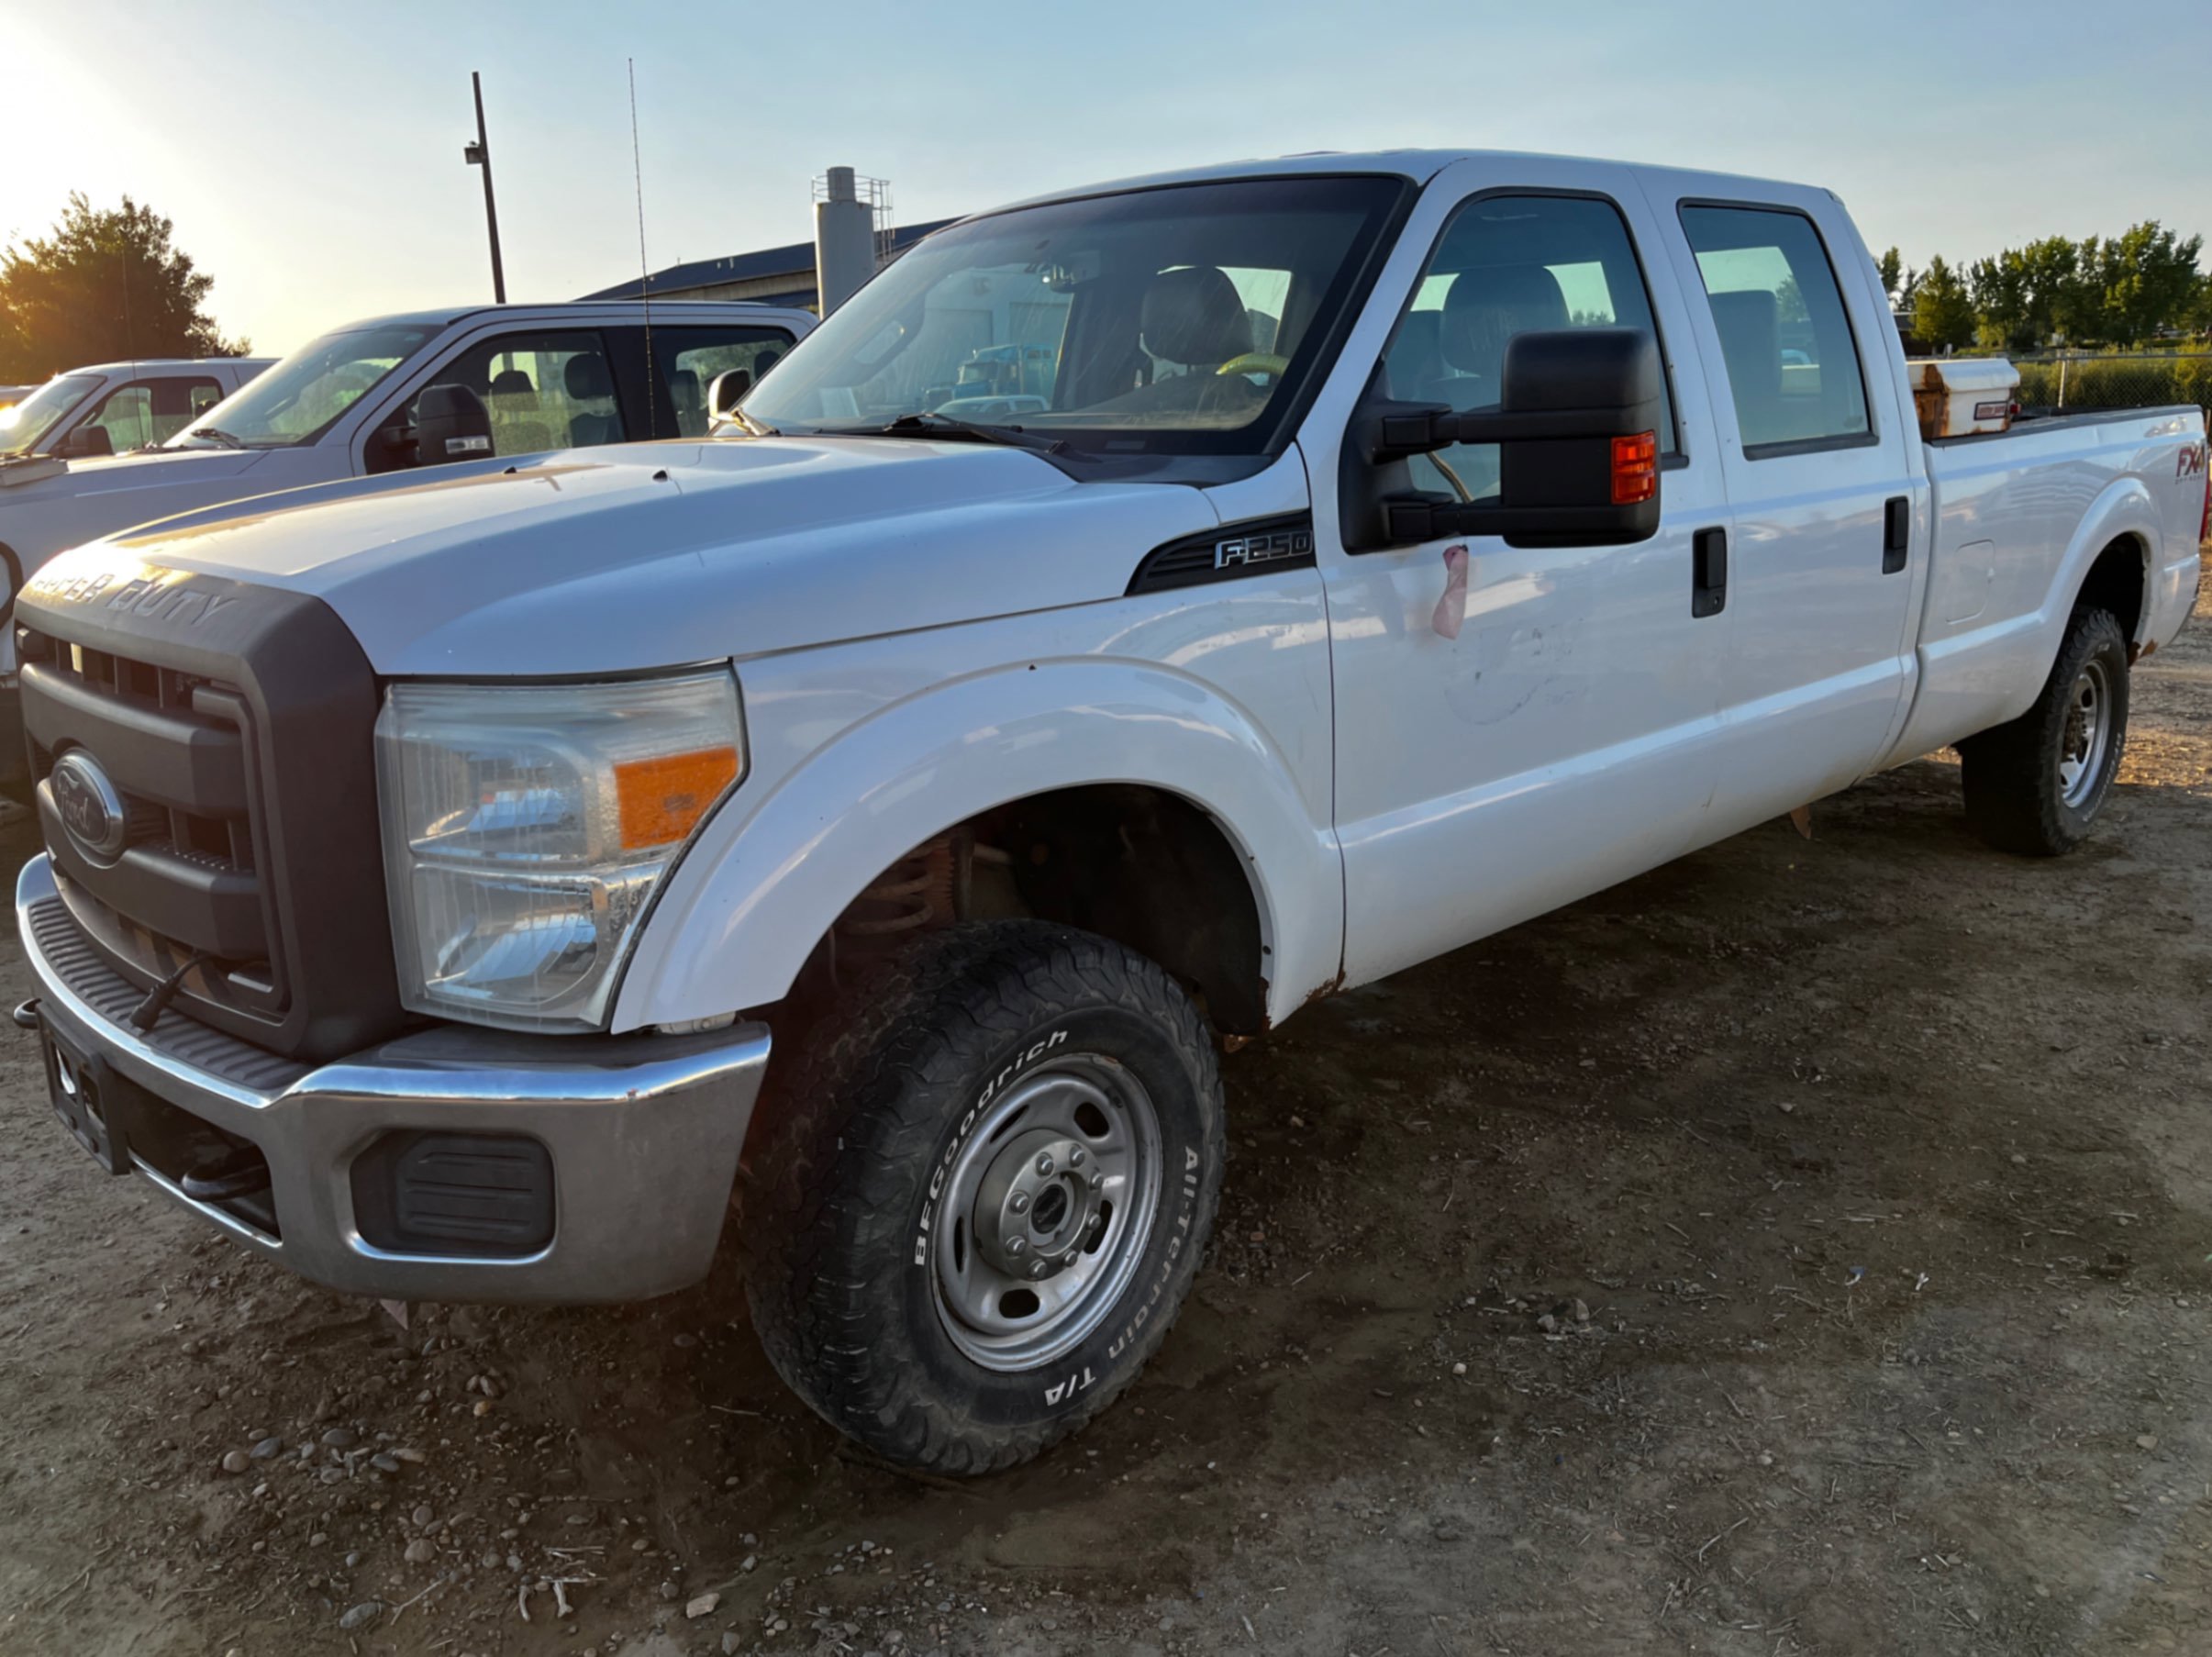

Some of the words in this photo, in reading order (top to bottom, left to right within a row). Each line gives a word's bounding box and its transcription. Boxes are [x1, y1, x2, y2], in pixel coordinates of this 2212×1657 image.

[105, 577, 239, 627] DUTY
[57, 770, 90, 832] Ford
[914, 1029, 1068, 1266] BFGoodrich
[1107, 1145, 1200, 1360] All-Terrain
[1044, 1366, 1096, 1407] T/A
